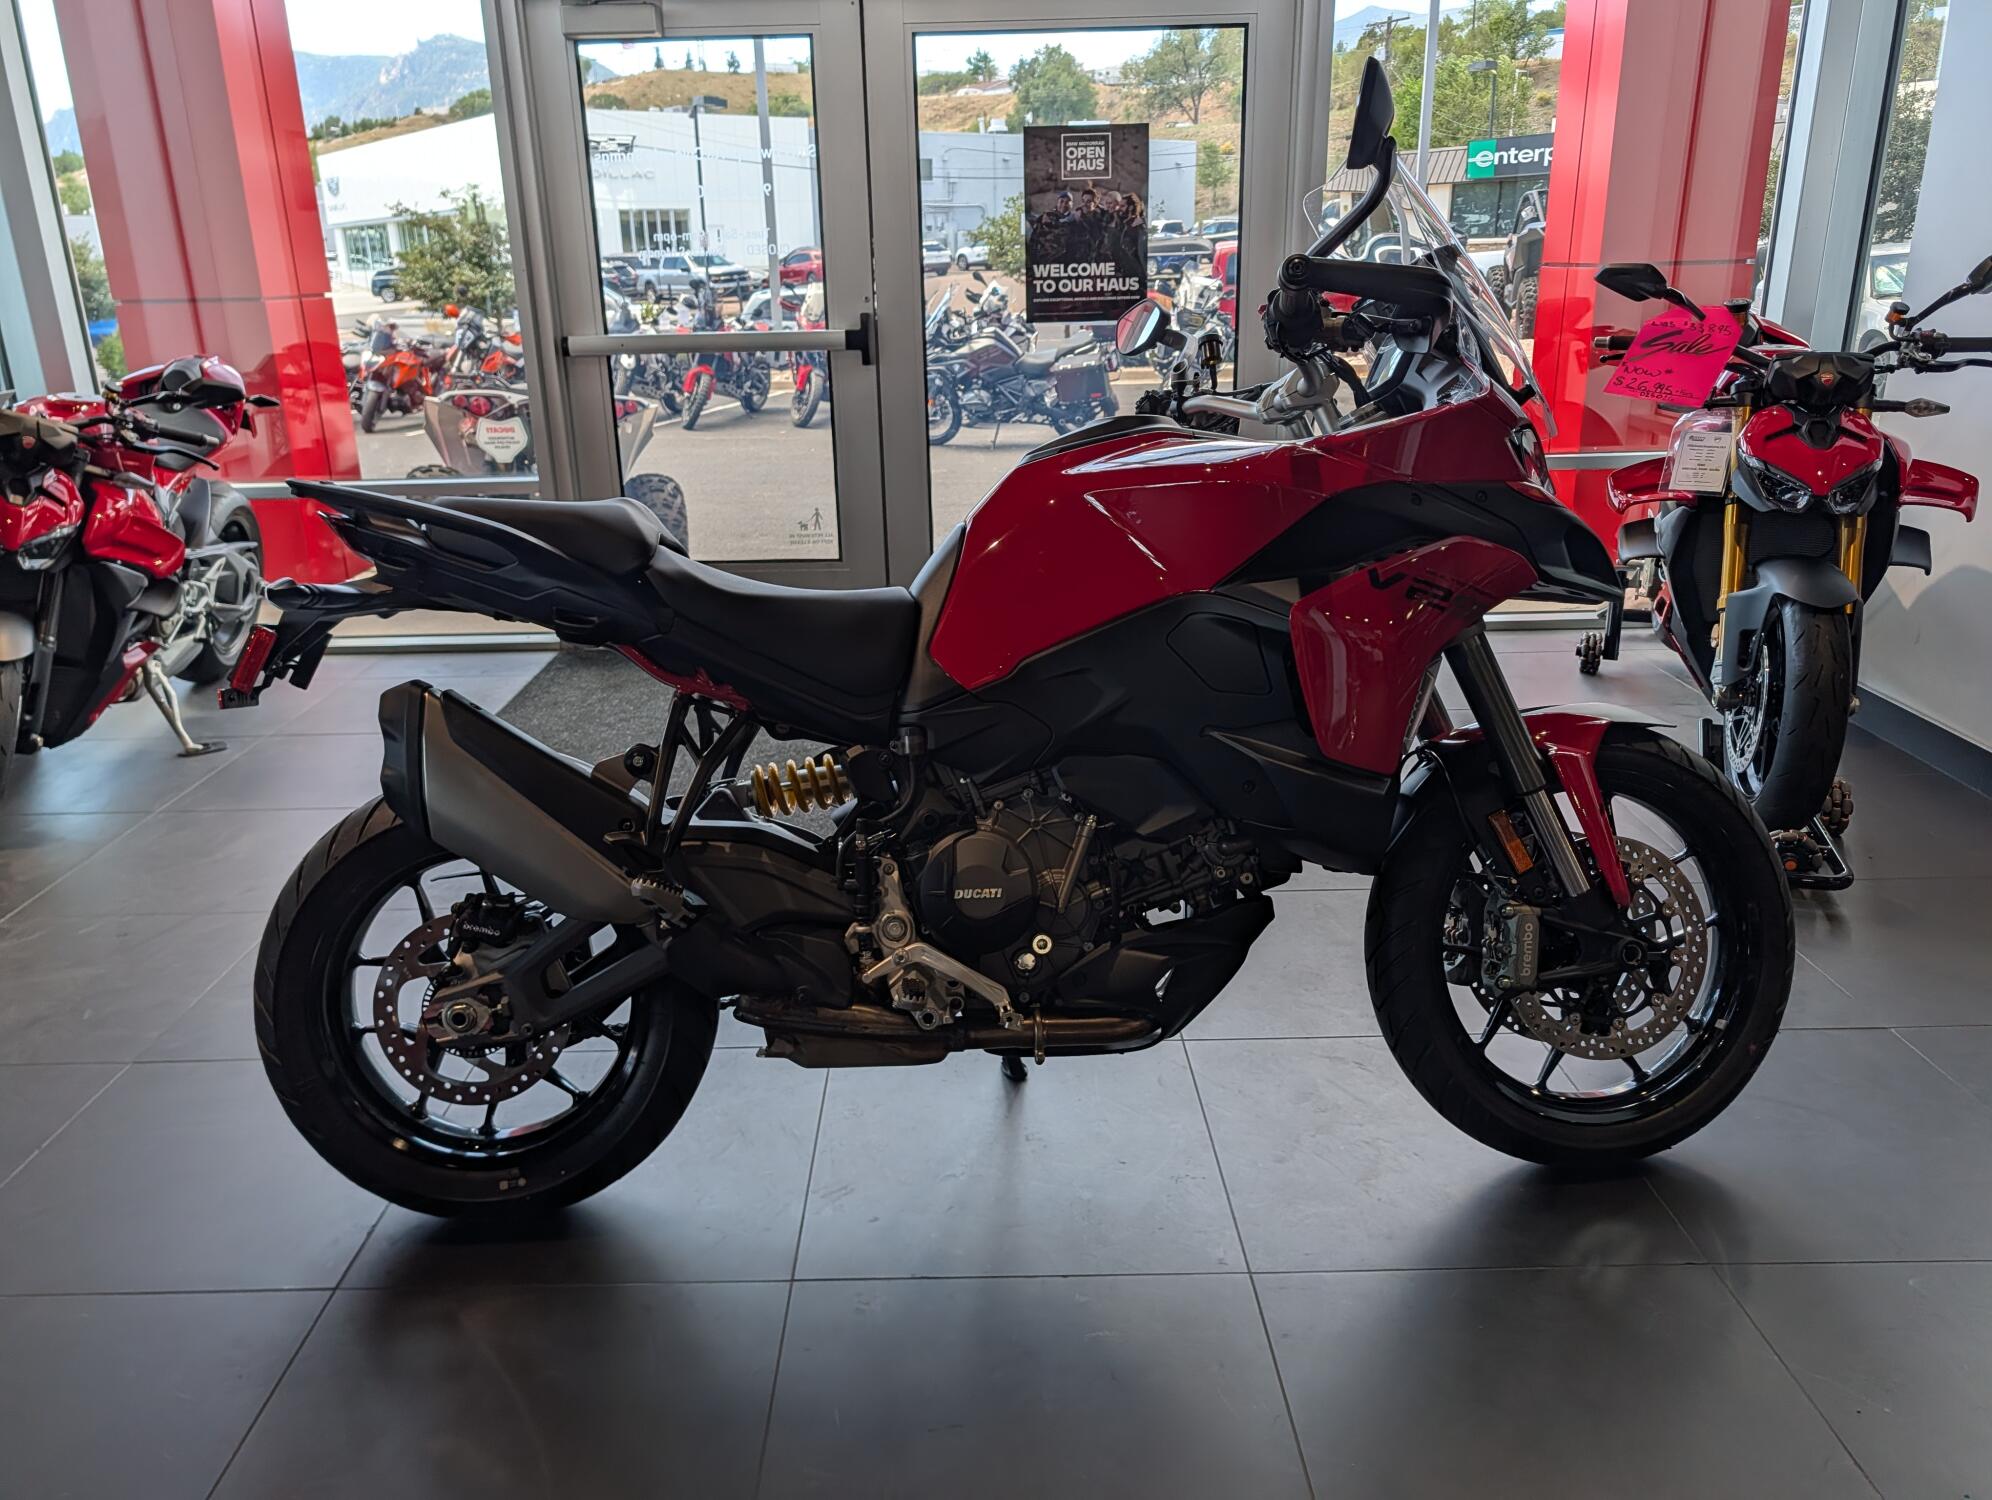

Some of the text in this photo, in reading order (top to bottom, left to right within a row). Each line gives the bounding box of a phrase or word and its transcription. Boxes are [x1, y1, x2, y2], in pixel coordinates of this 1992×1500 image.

[1066, 146, 1105, 159] OPEN
[1066, 159, 1105, 171] HAUS
[1032, 262, 1116, 277] WELCOME
[1033, 277, 1140, 293] TO OUR HAUS
[1628, 329, 1729, 362] Sale
[954, 888, 1003, 900] DUCATI
[462, 922, 501, 937] brembo
[1519, 922, 1534, 977] brembo
